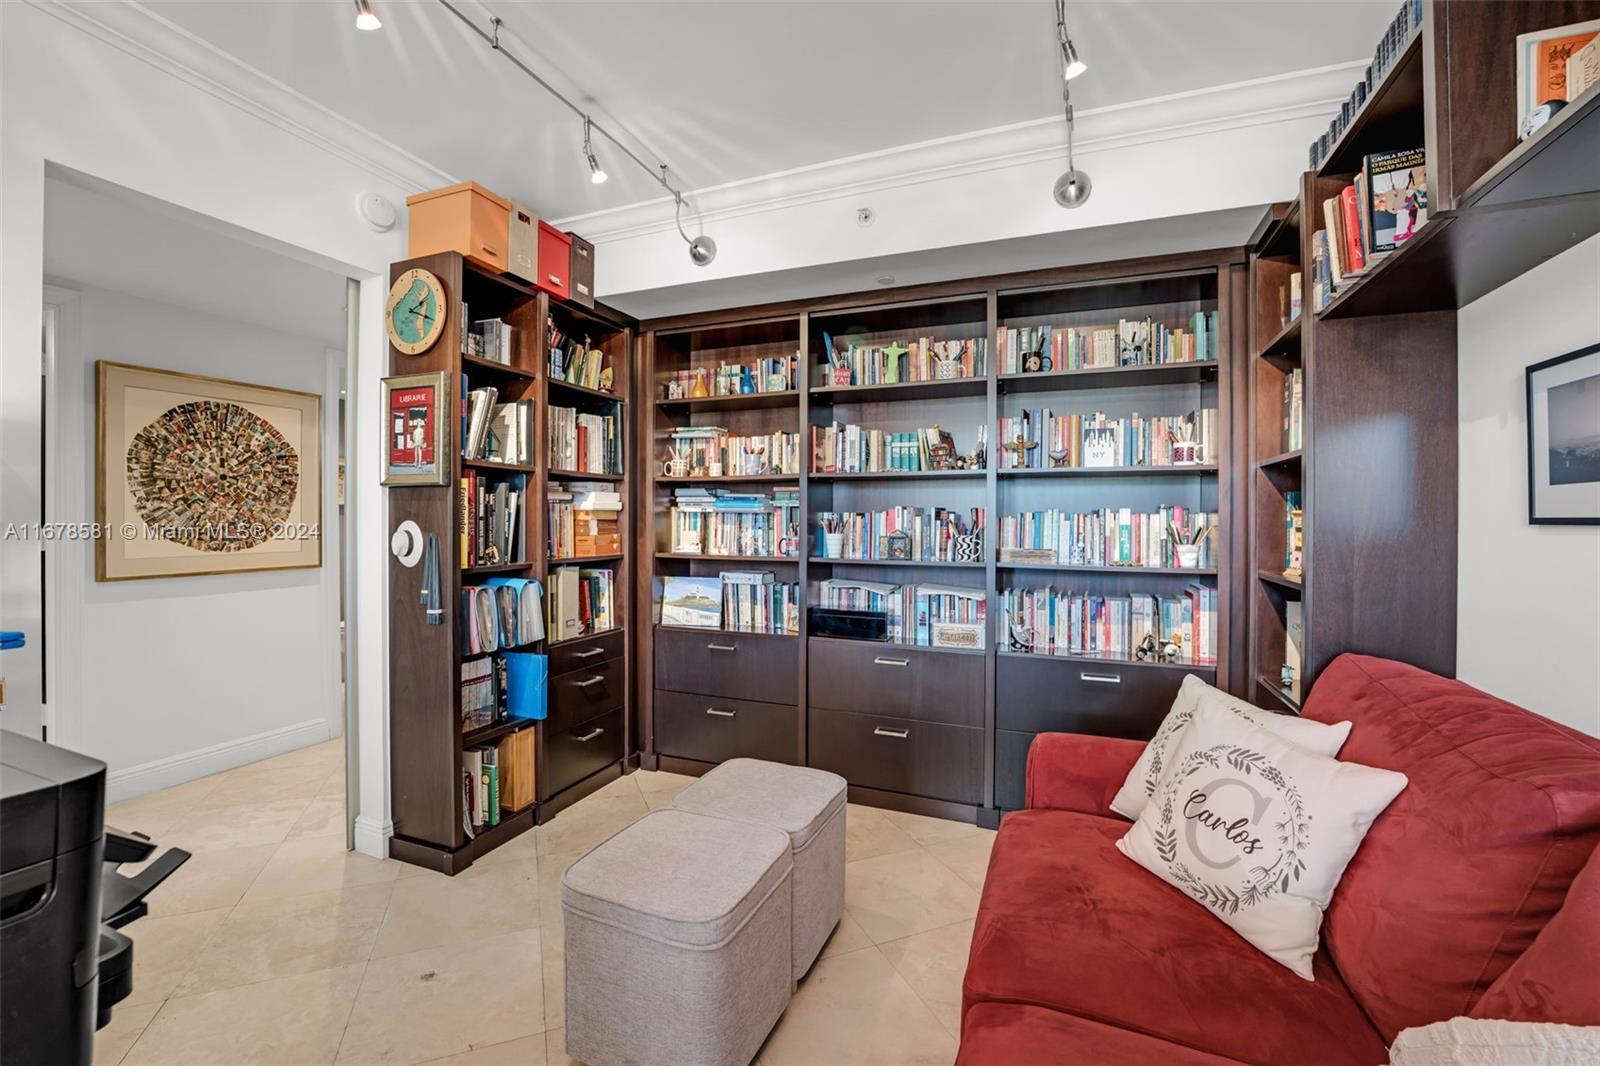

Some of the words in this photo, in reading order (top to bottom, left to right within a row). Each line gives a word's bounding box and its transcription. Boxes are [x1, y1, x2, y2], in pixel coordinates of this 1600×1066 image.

[1372, 154, 1396, 162] CAMILA
[1378, 157, 1407, 166] PARQUE
[1183, 789, 1264, 854] Carlos
